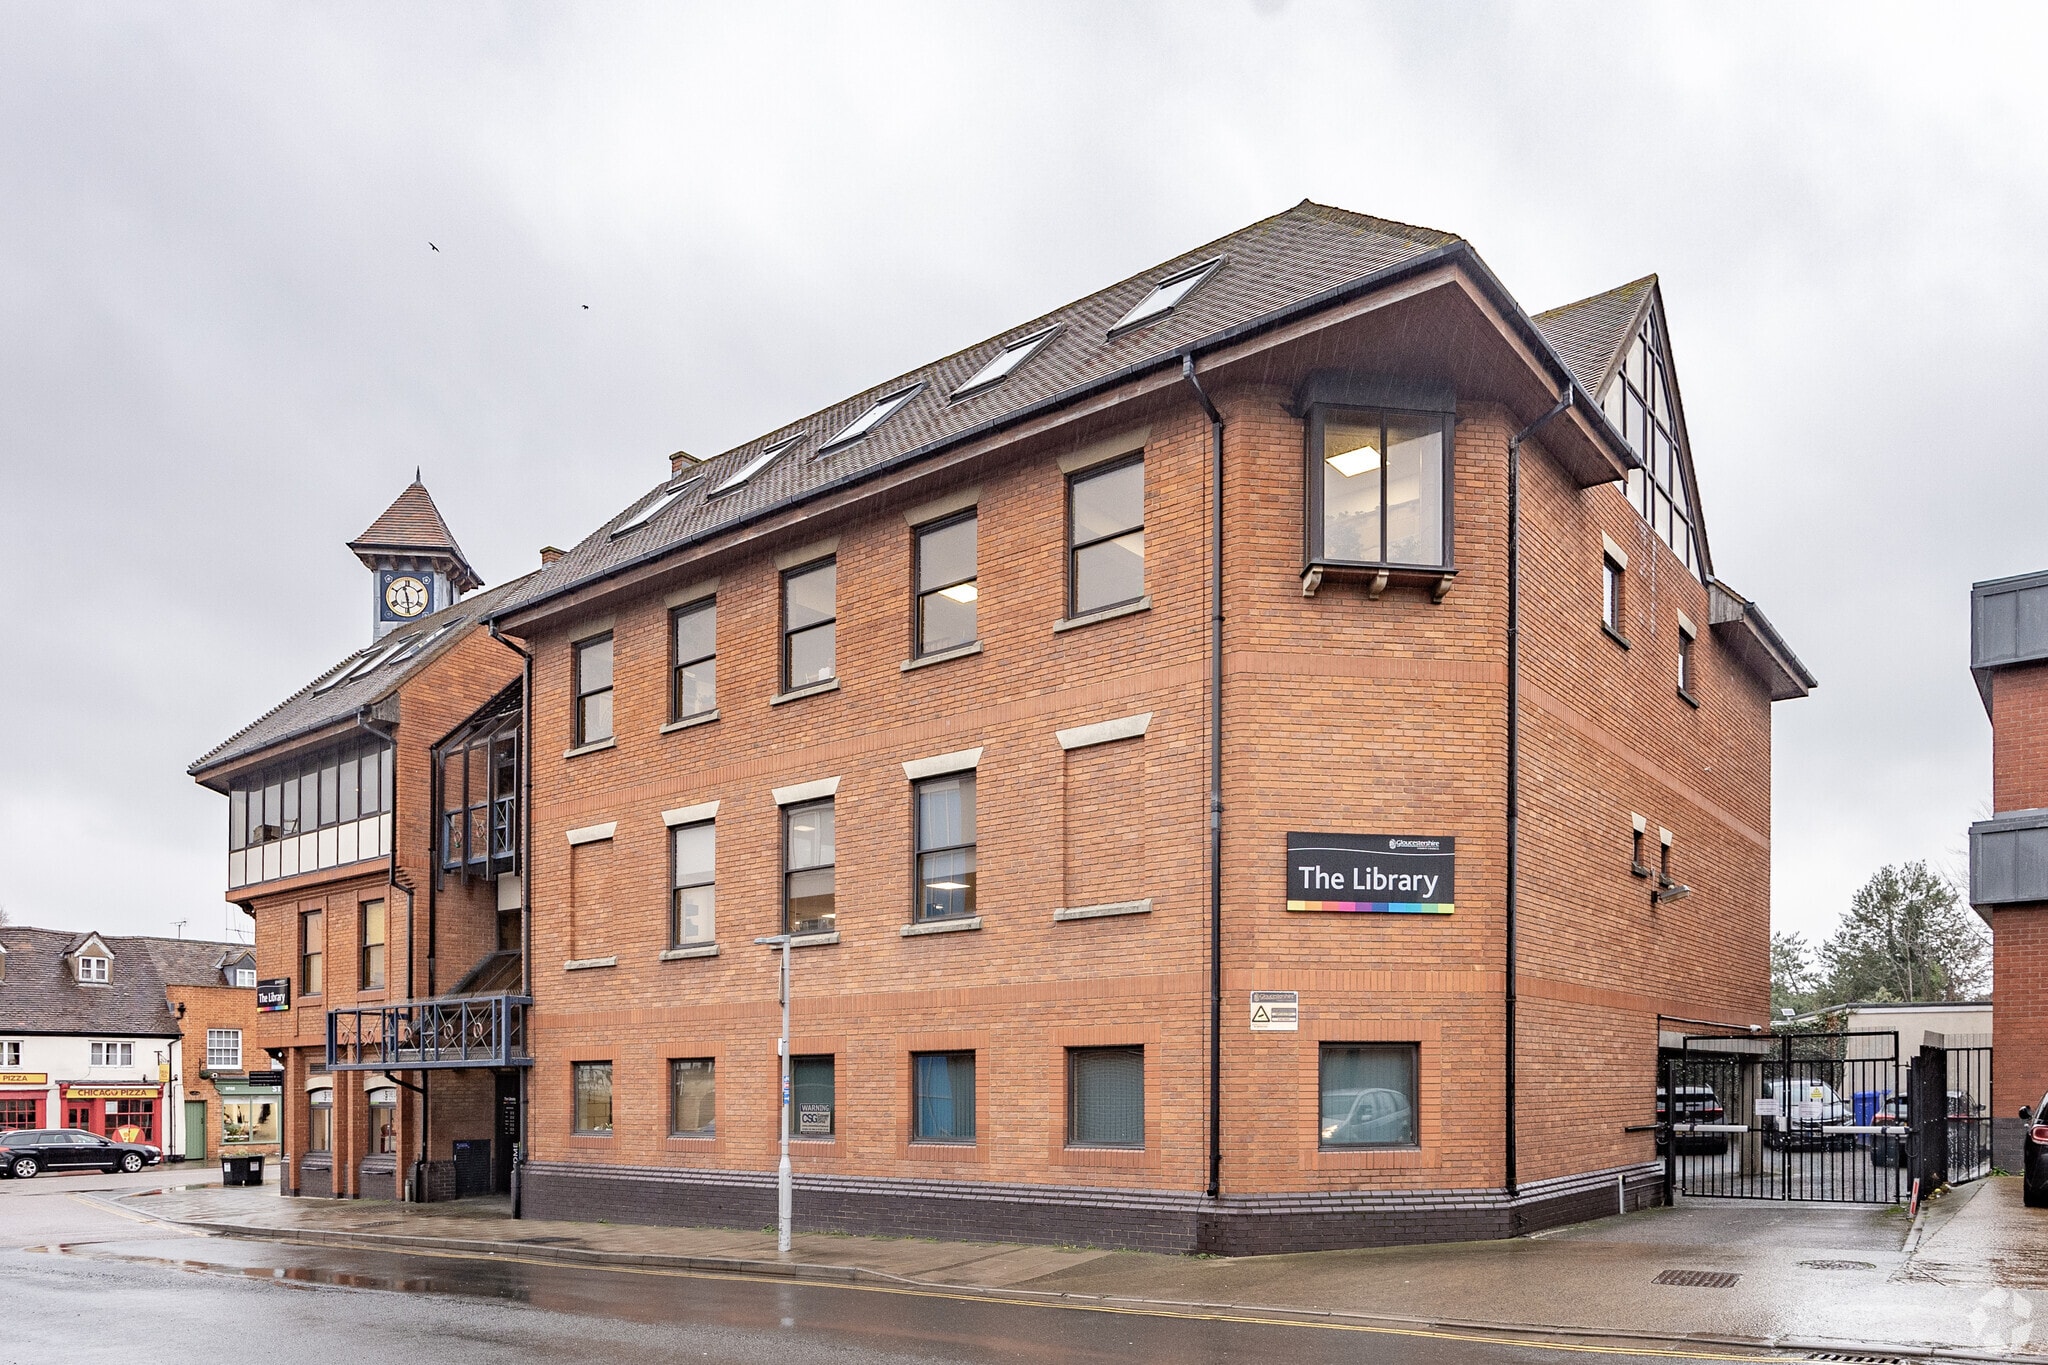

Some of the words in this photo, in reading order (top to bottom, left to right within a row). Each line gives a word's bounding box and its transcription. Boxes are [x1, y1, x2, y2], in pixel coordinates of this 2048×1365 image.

[1299, 866, 1345, 890] The
[1353, 867, 1439, 899] Library
[259, 993, 267, 1003] The
[268, 992, 285, 1005] Library
[77, 1089, 118, 1097] CHICAGO
[802, 1113, 817, 1123] CSG
